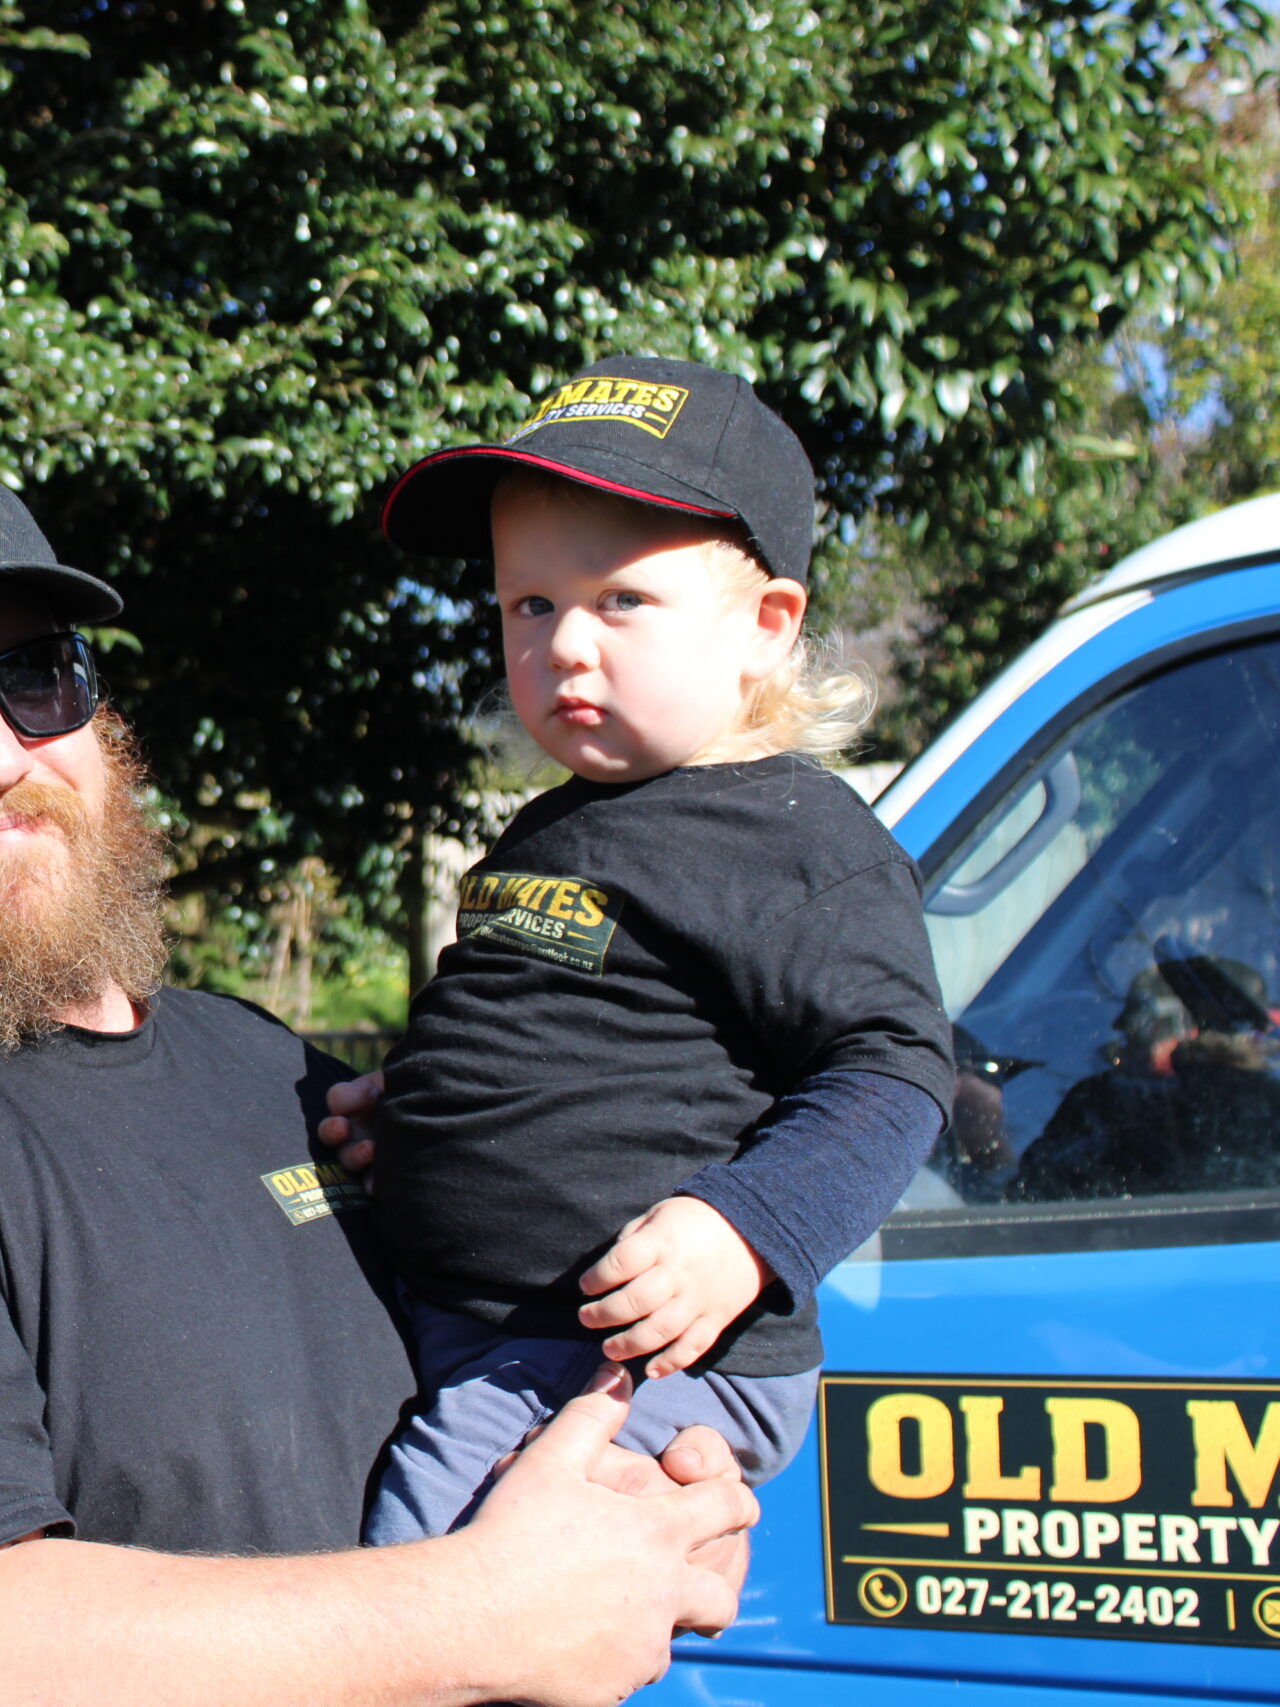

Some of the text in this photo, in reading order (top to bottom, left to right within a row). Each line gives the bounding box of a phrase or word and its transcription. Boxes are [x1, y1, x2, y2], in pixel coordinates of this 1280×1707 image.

[551, 380, 680, 412] MATES
[568, 402, 646, 418] SERVICES
[496, 877, 608, 927] MATES
[498, 908, 565, 939] RVICES
[271, 1167, 320, 1197] OLD
[866, 1392, 1142, 1503] OLD
[962, 1506, 1280, 1566] PROPERTY
[915, 1574, 1200, 1628] 027-212-2402
